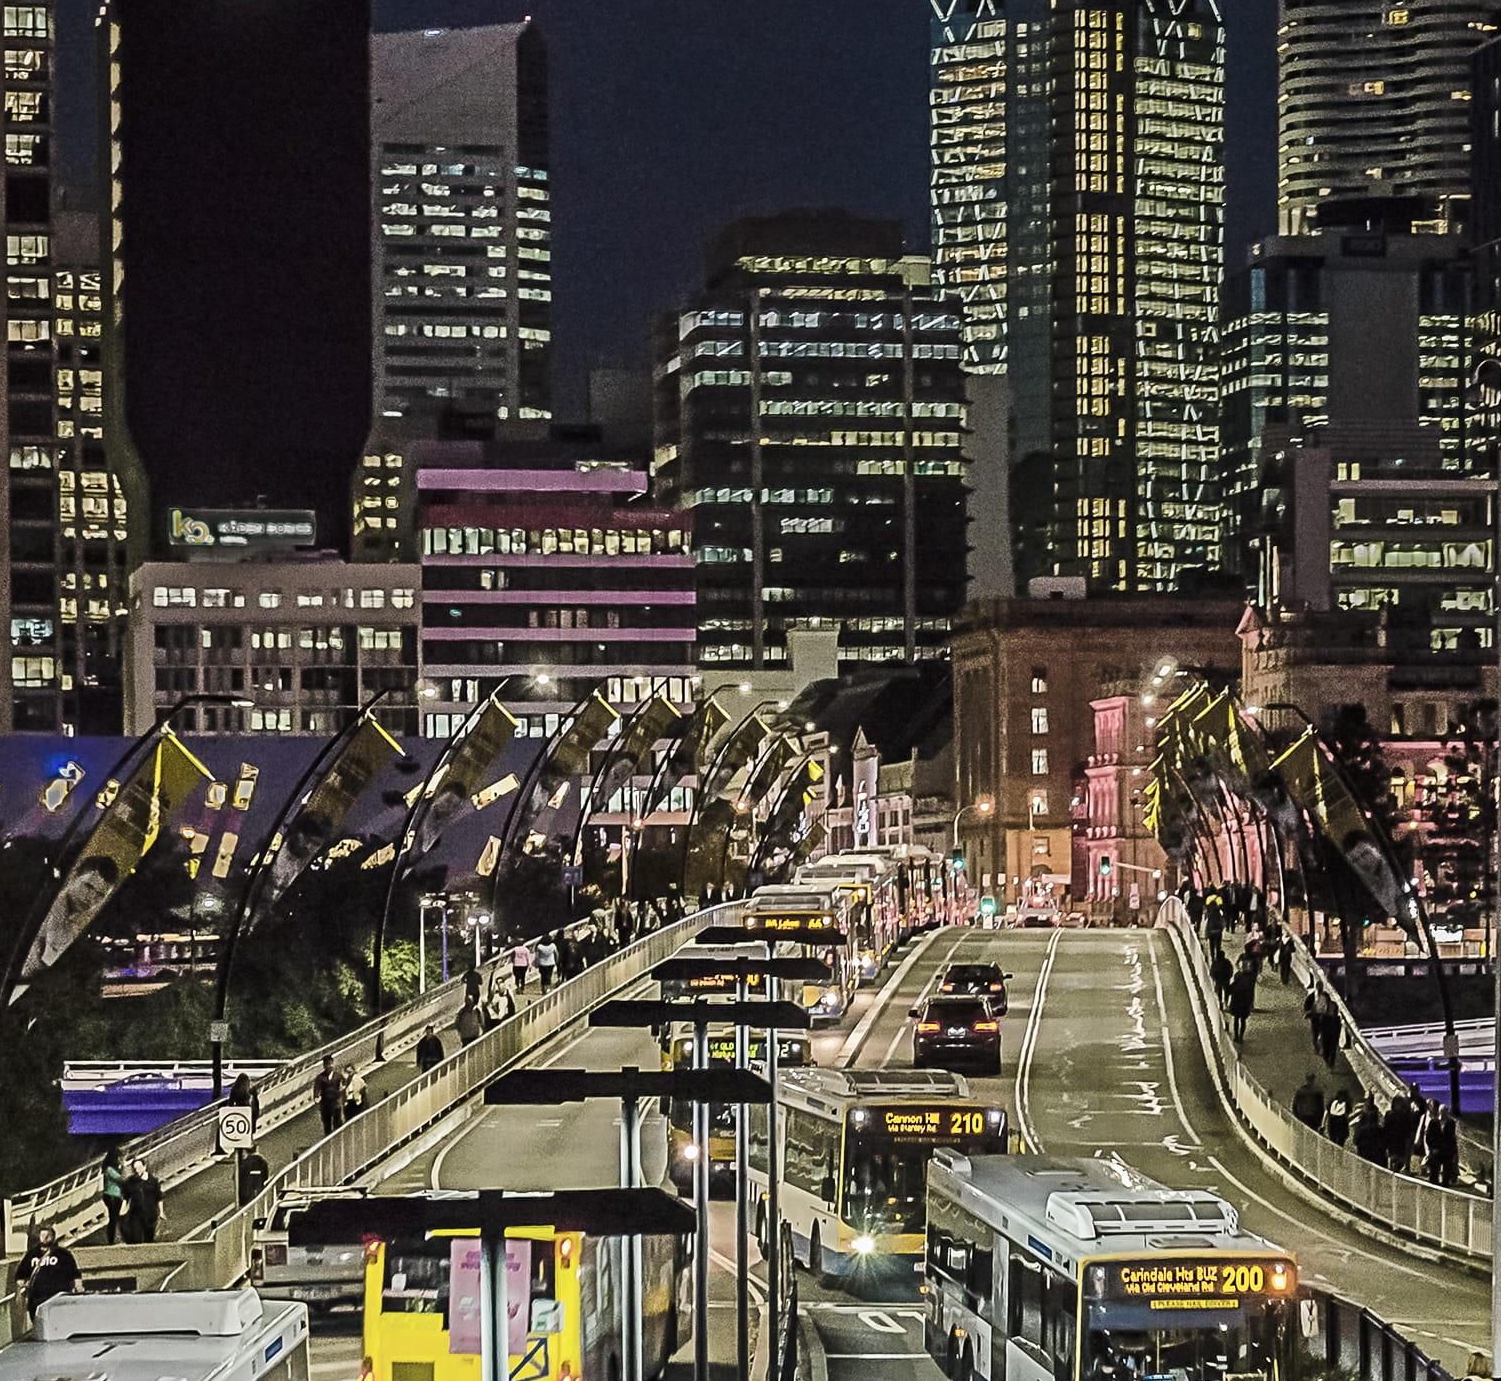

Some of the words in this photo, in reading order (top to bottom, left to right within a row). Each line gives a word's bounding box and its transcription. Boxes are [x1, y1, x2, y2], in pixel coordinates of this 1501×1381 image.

[226, 1120, 247, 1135] 50
[885, 1112, 922, 1124] Cannon
[951, 1113, 983, 1134] 210
[1121, 1268, 1173, 1282] Carindale
[1197, 1266, 1217, 1281] BUZ
[1222, 1266, 1263, 1292] 200
[1202, 1281, 1214, 1292] Rd
